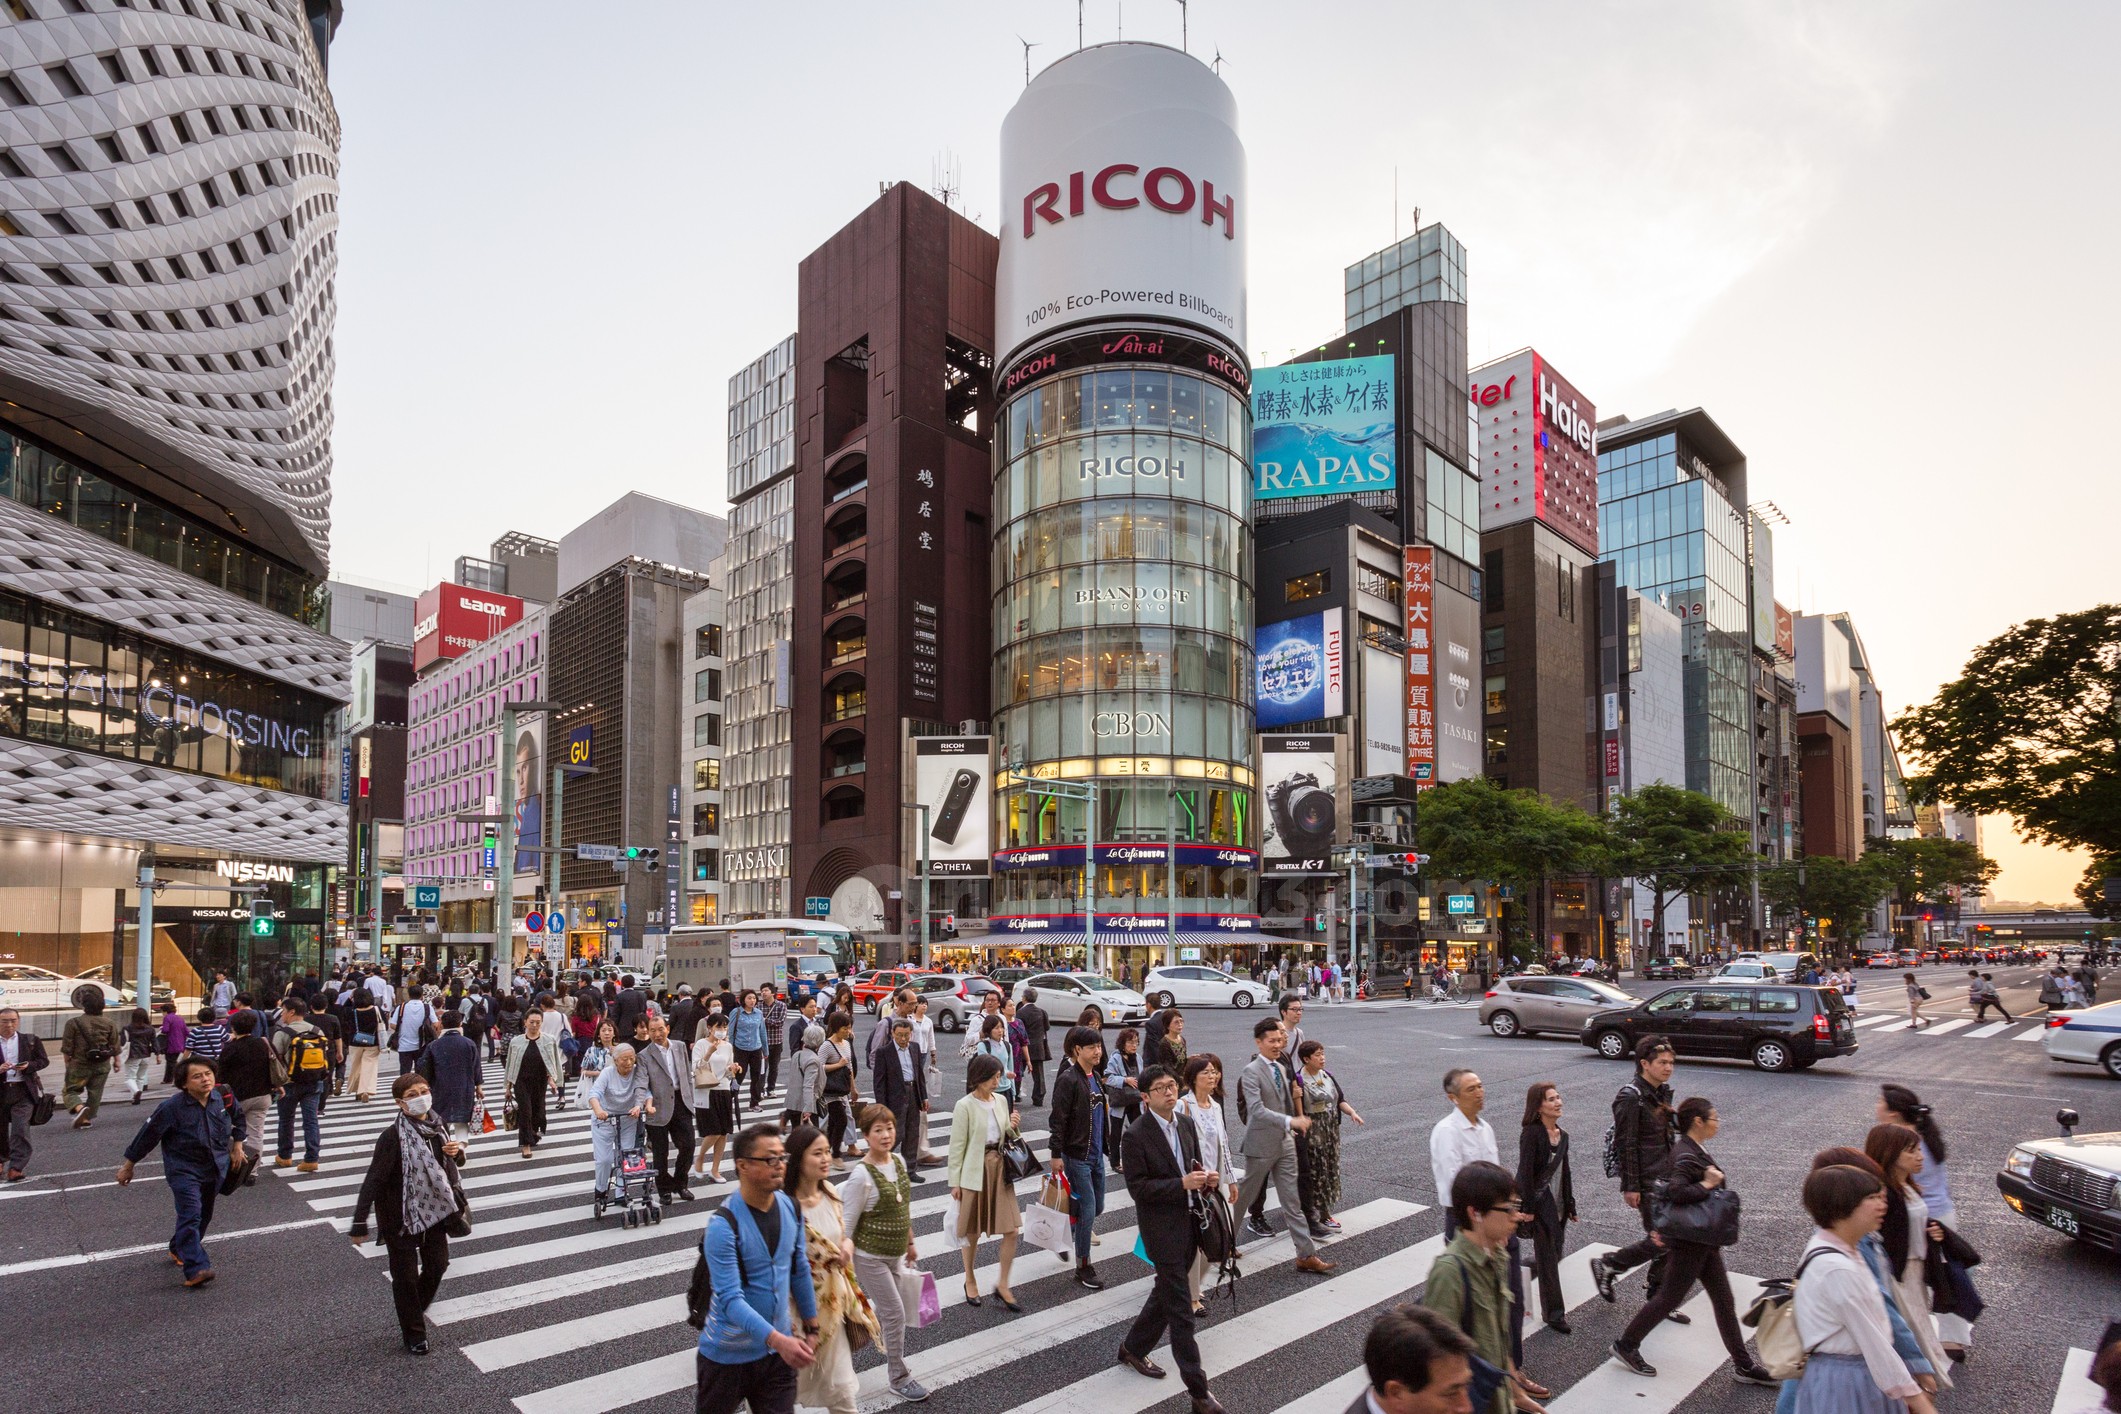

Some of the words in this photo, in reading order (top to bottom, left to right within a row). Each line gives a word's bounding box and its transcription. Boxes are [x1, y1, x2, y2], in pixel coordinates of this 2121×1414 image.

[1023, 163, 1234, 240] RICOH
[1025, 300, 1061, 328] 100%
[1066, 289, 1174, 311] Eco-Powered
[1179, 293, 1234, 330] Billboard
[1006, 353, 1056, 390] RICOH
[1207, 353, 1251, 390] RICOH
[1279, 364, 1367, 384] 美しさは健康から
[1471, 374, 1517, 407] ier
[1539, 372, 1599, 457] Haier
[1079, 455, 1185, 481] RICOH
[1257, 452, 1390, 491] RAPAS
[916, 468, 934, 551] 鳩居堂
[1406, 562, 1430, 573] ブランド
[1414, 573, 1422, 581] &
[1075, 587, 1147, 604] BRAND
[1152, 587, 1190, 604] OFF
[1406, 581, 1431, 592] チケット
[460, 597, 507, 617] Laox
[1110, 602, 1166, 612] TOKYO
[413, 611, 438, 643] Laox
[1409, 602, 1430, 675] 大黒屋
[1258, 662, 1277, 672] Love
[1279, 658, 1298, 668] your
[1301, 653, 1322, 662] ride.
[1326, 630, 1340, 693] FUJITEC
[1410, 686, 1429, 706] 質
[1640, 679, 1675, 732] Dior
[139, 681, 310, 757] CROSSING
[1090, 711, 1171, 738] C'BON
[1407, 708, 1432, 726] 買取
[1407, 728, 1432, 745] 販売
[1443, 722, 1477, 743] TASAKI
[570, 740, 590, 765] GU
[725, 848, 785, 871] TASAKI
[1106, 849, 1118, 858] Le
[1118, 847, 1139, 862] Café
[1138, 850, 1165, 859] DOUTOR
[1301, 859, 1324, 870] K-1
[216, 859, 294, 882] NISSAN
[943, 863, 972, 871] THETA
[192, 909, 228, 917] NISSAN
[586, 906, 596, 917] GU
[607, 920, 618, 928] GU
[1106, 917, 1118, 927] Le
[1118, 916, 1139, 932] Café
[1138, 919, 1165, 928] DOUTOR
[2051, 1213, 2078, 1234] 56-35
